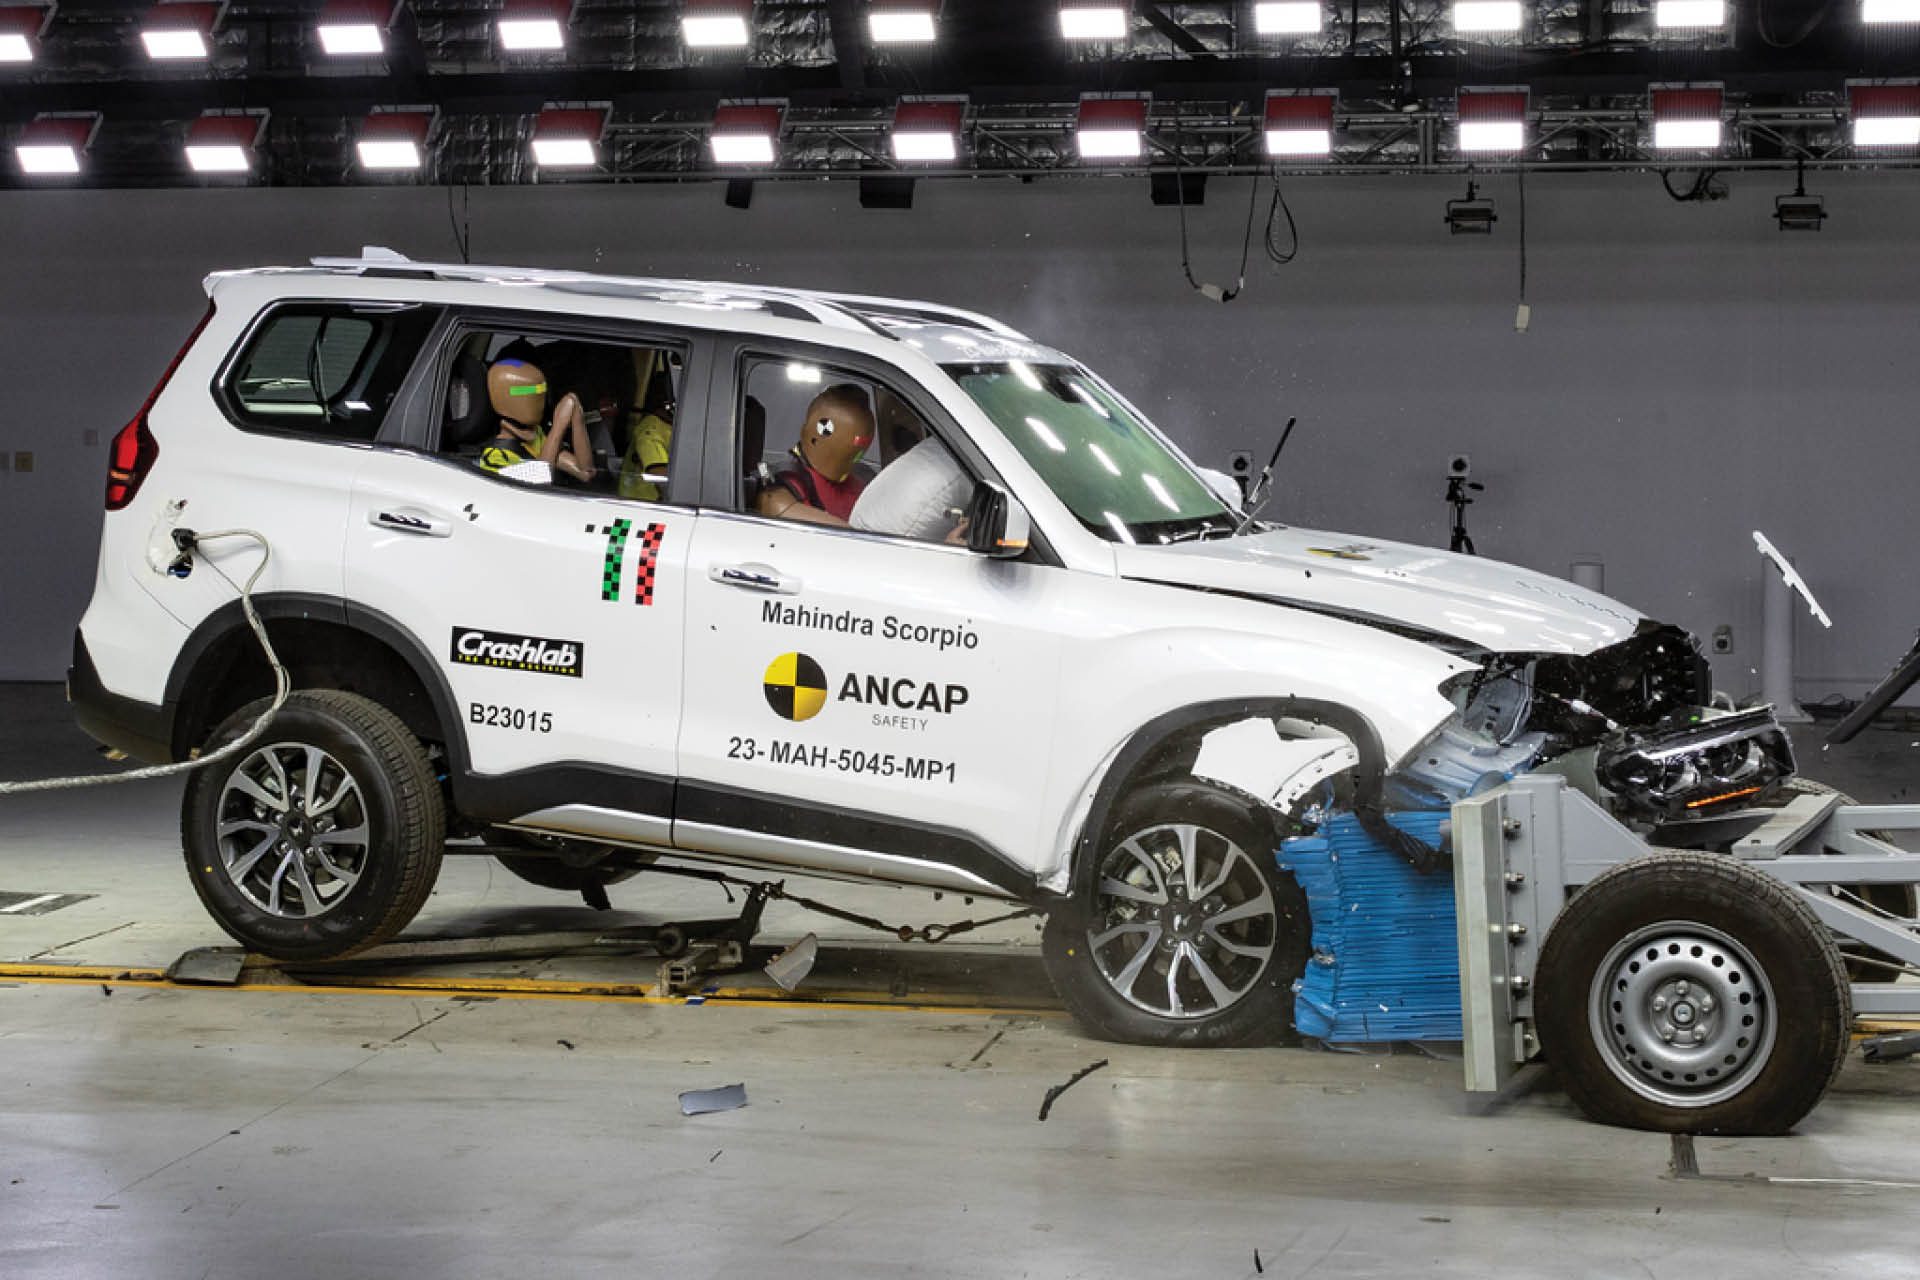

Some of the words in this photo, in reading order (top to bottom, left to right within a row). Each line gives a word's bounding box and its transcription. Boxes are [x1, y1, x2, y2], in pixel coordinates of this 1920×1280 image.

[762, 600, 873, 635] Mahindra
[882, 616, 978, 650] Scorpio
[457, 632, 576, 666] Crashlab
[837, 672, 969, 714] ANCAP
[470, 702, 553, 733] B23015
[871, 713, 928, 731] SAFETY
